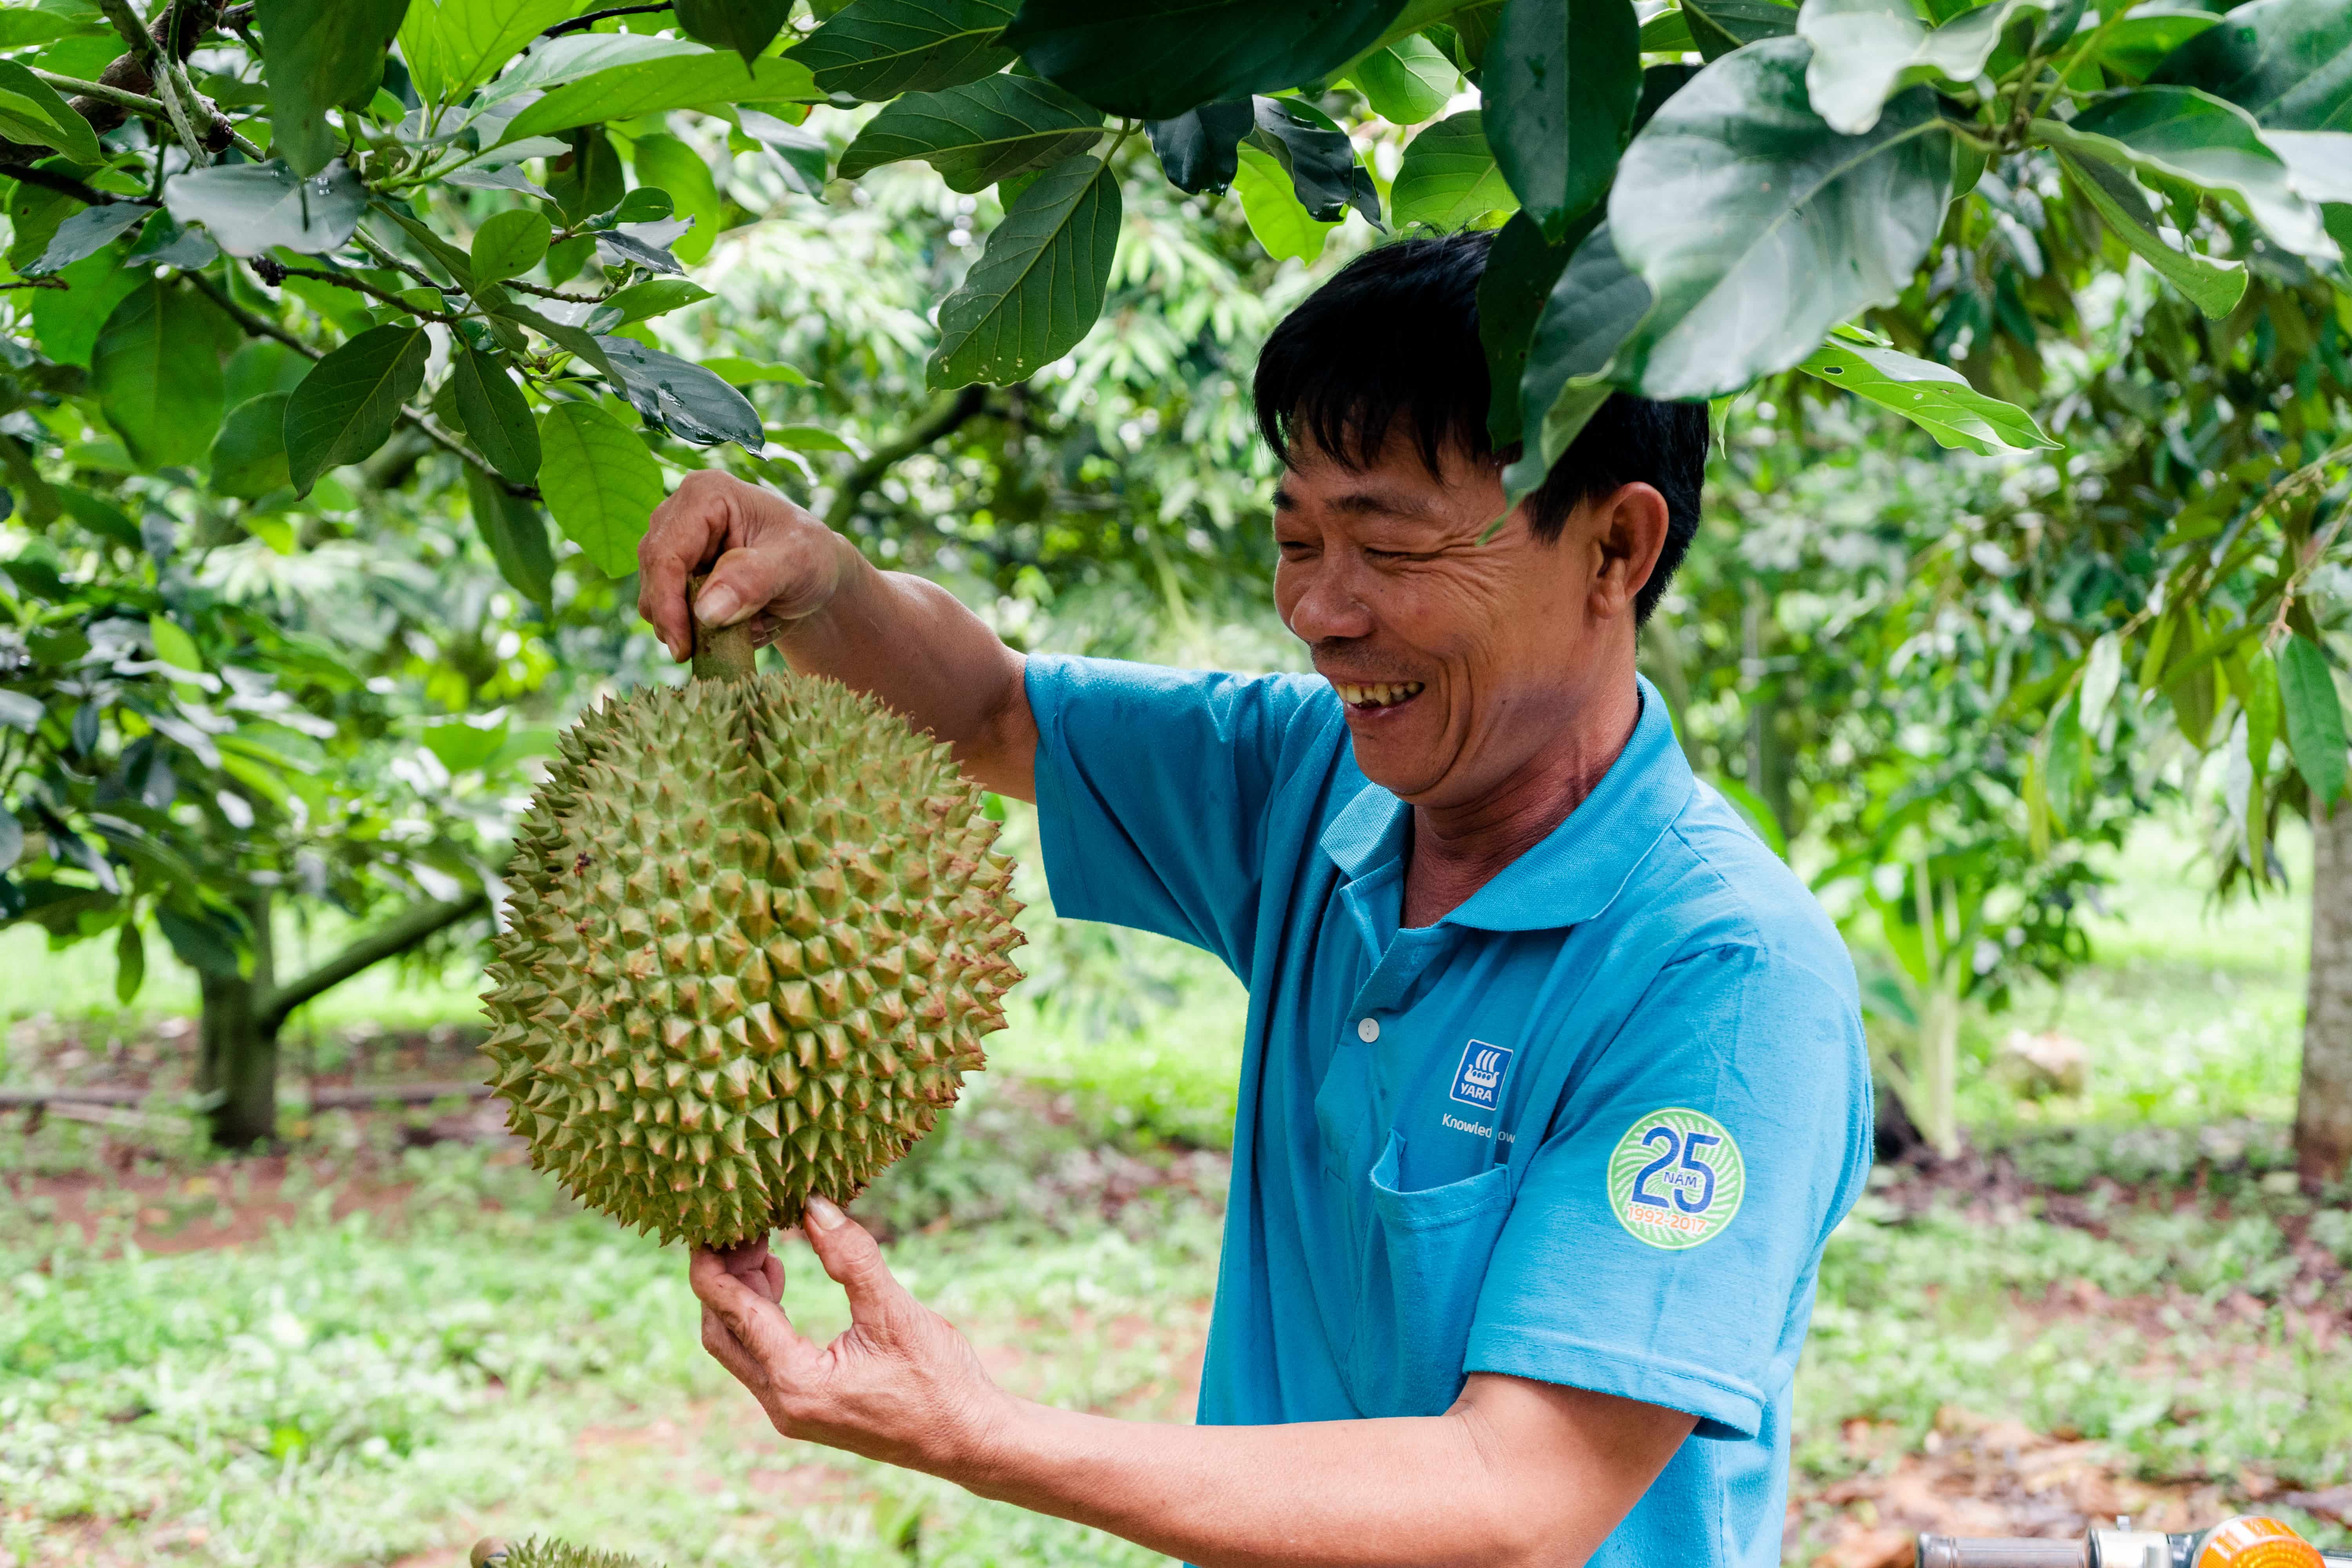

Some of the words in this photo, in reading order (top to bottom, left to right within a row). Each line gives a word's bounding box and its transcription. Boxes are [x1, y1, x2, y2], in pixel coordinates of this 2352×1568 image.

[1460, 1082, 1492, 1102] YARA
[1441, 1113, 1493, 1138] Knowled
[1631, 1127, 1721, 1214] 25
[1664, 1171, 1697, 1188] NĂM
[1629, 1207, 1707, 1233] 1992-2017
